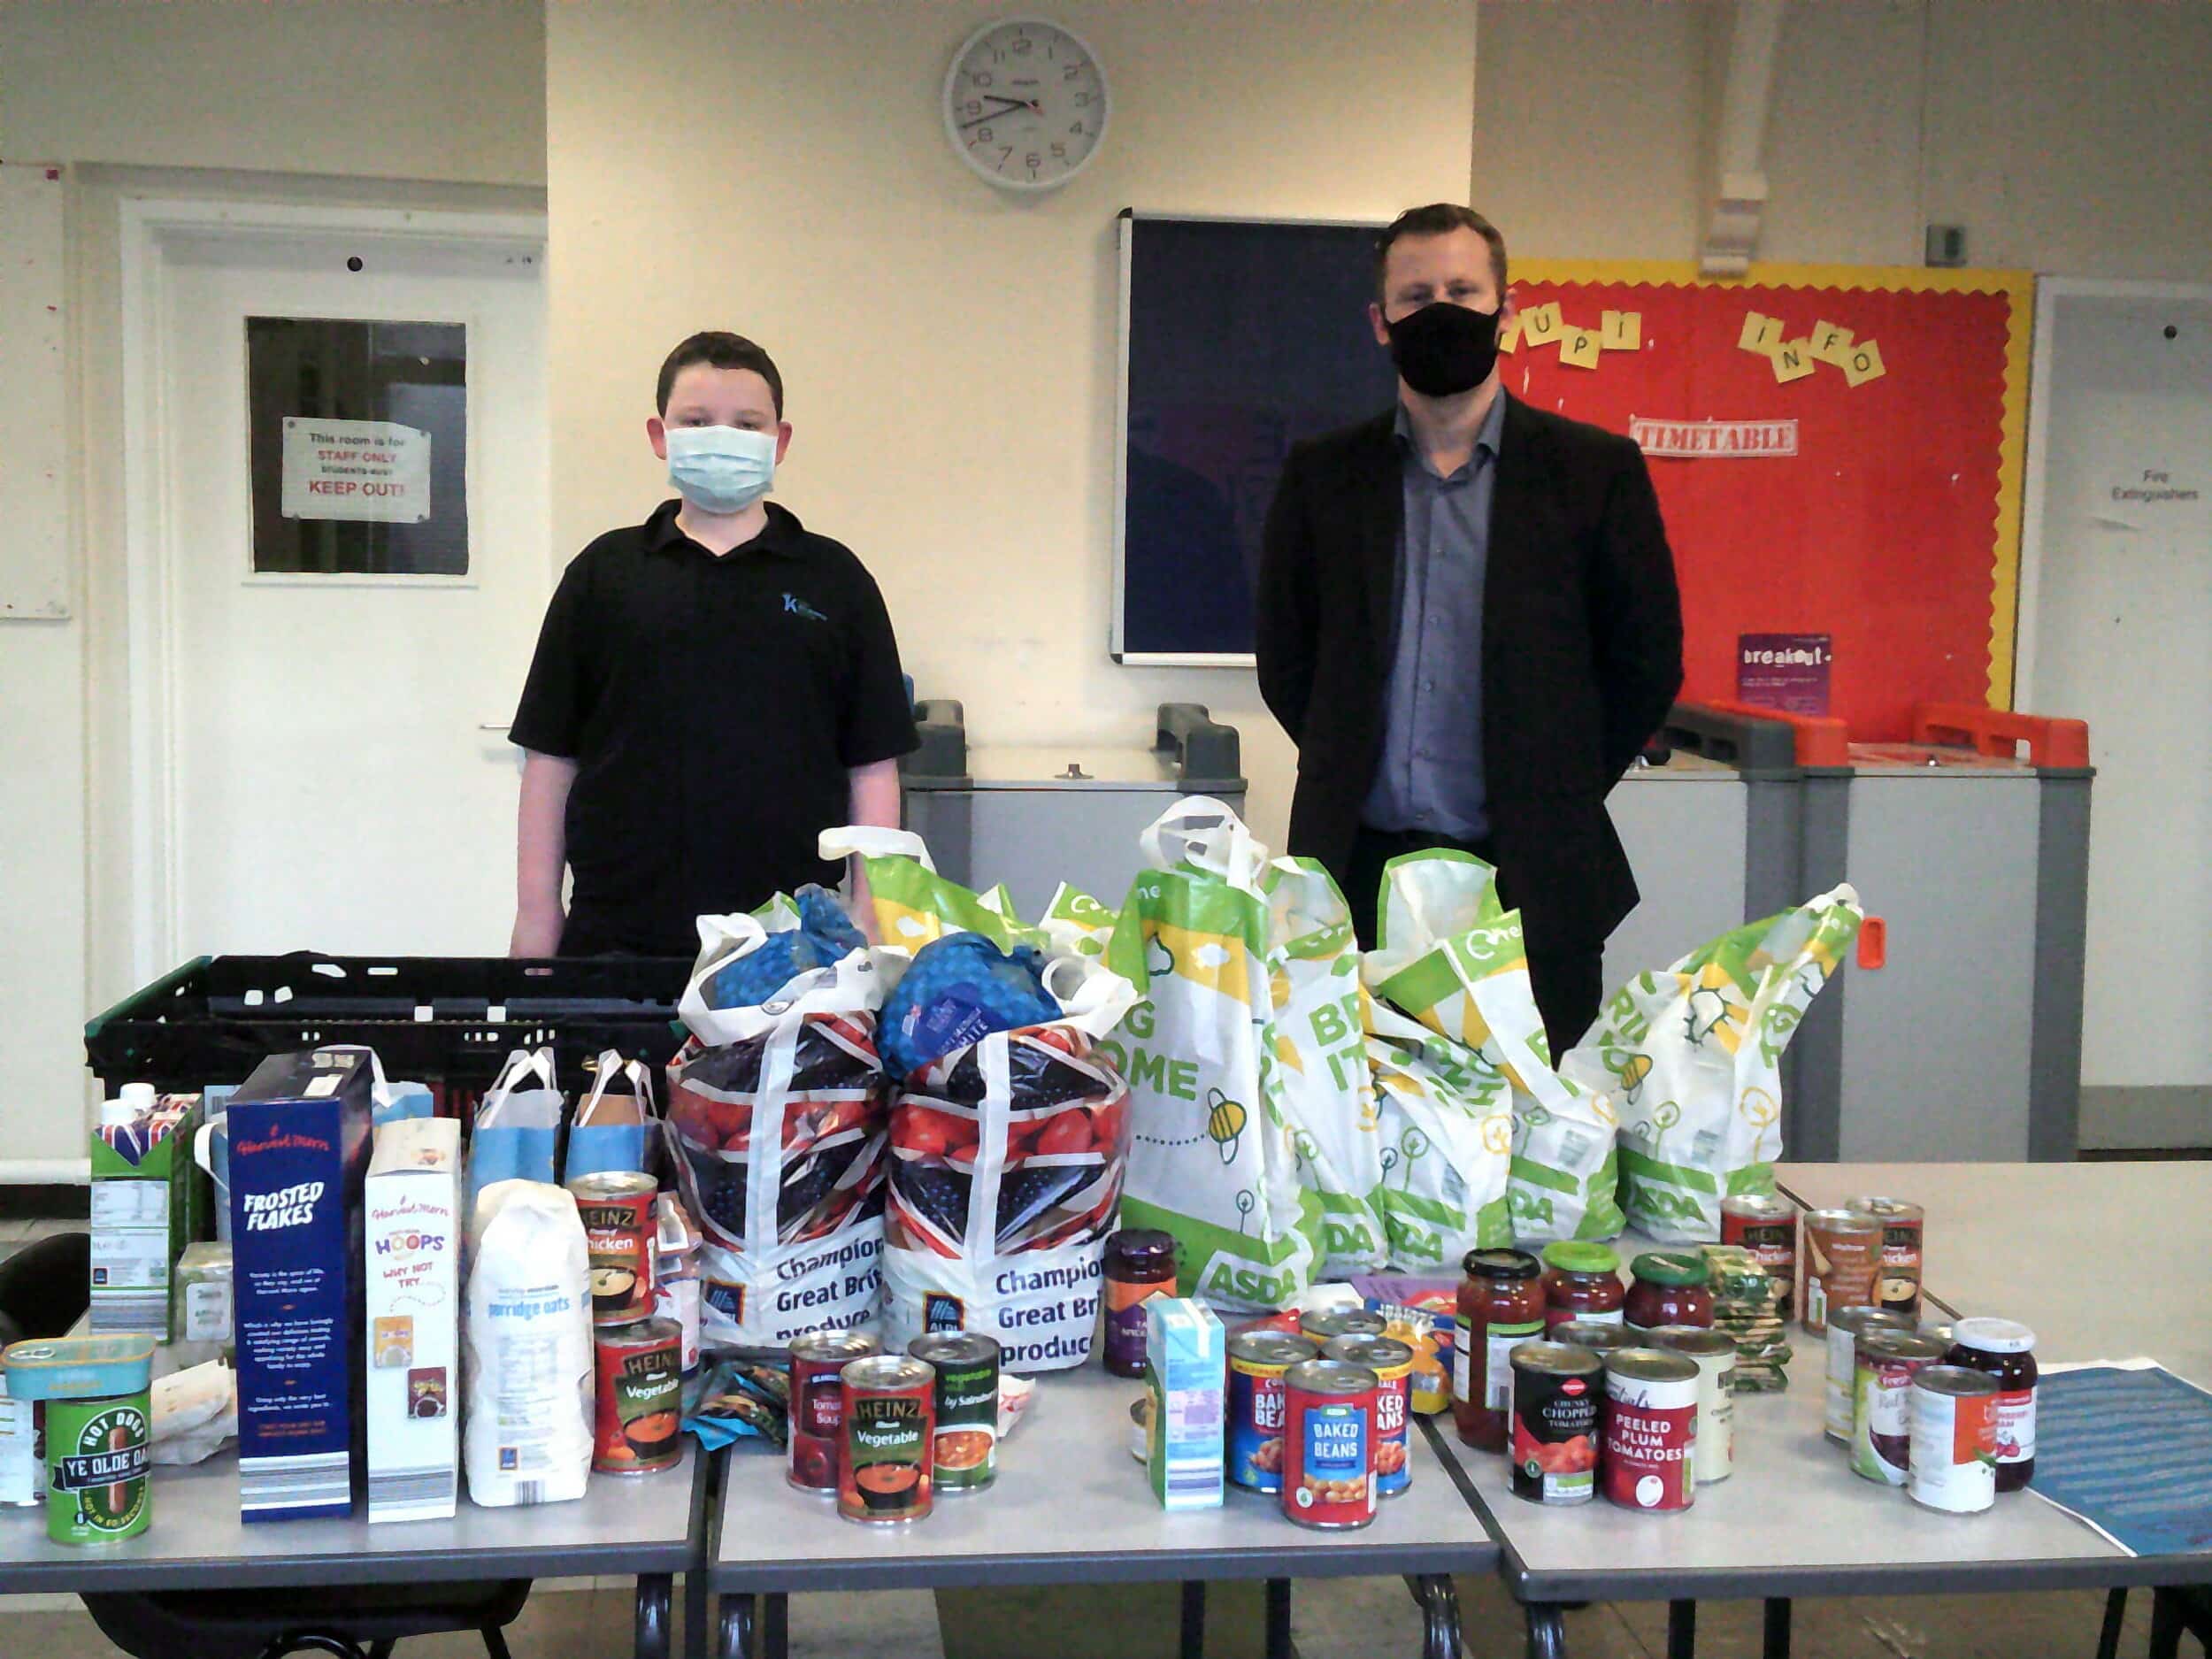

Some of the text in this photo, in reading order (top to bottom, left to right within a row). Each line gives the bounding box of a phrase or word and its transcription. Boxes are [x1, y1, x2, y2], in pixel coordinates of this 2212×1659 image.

[310, 433, 335, 444] This
[339, 436, 370, 445] room
[1638, 424, 1791, 450] TIMETABLE
[318, 449, 397, 463] STAFF ONLY
[310, 480, 405, 496] KEEP OUT!
[243, 1181, 326, 1213] FROSTED
[246, 1203, 314, 1231] FLAKES
[586, 1209, 634, 1226] EINZ
[375, 1234, 445, 1255] HOOPS
[587, 1237, 634, 1250] hicken
[1206, 1263, 1298, 1305] ASDA
[544, 1296, 572, 1315] oats
[777, 1281, 840, 1312] Great
[998, 1301, 1066, 1329] Great
[627, 1350, 675, 1374] HEIN
[859, 1400, 918, 1417] HEINZ
[83, 1417, 109, 1447] HOT
[1314, 1423, 1359, 1438] BAKED
[1616, 1413, 1671, 1433] PEELED
[856, 1429, 919, 1448] Vegetable
[1621, 1429, 1663, 1447] PLUM
[1314, 1441, 1358, 1458] BEANS
[1608, 1436, 1682, 1462] TOMATOES
[67, 1459, 88, 1477] YE
[92, 1453, 130, 1475] OLDE
